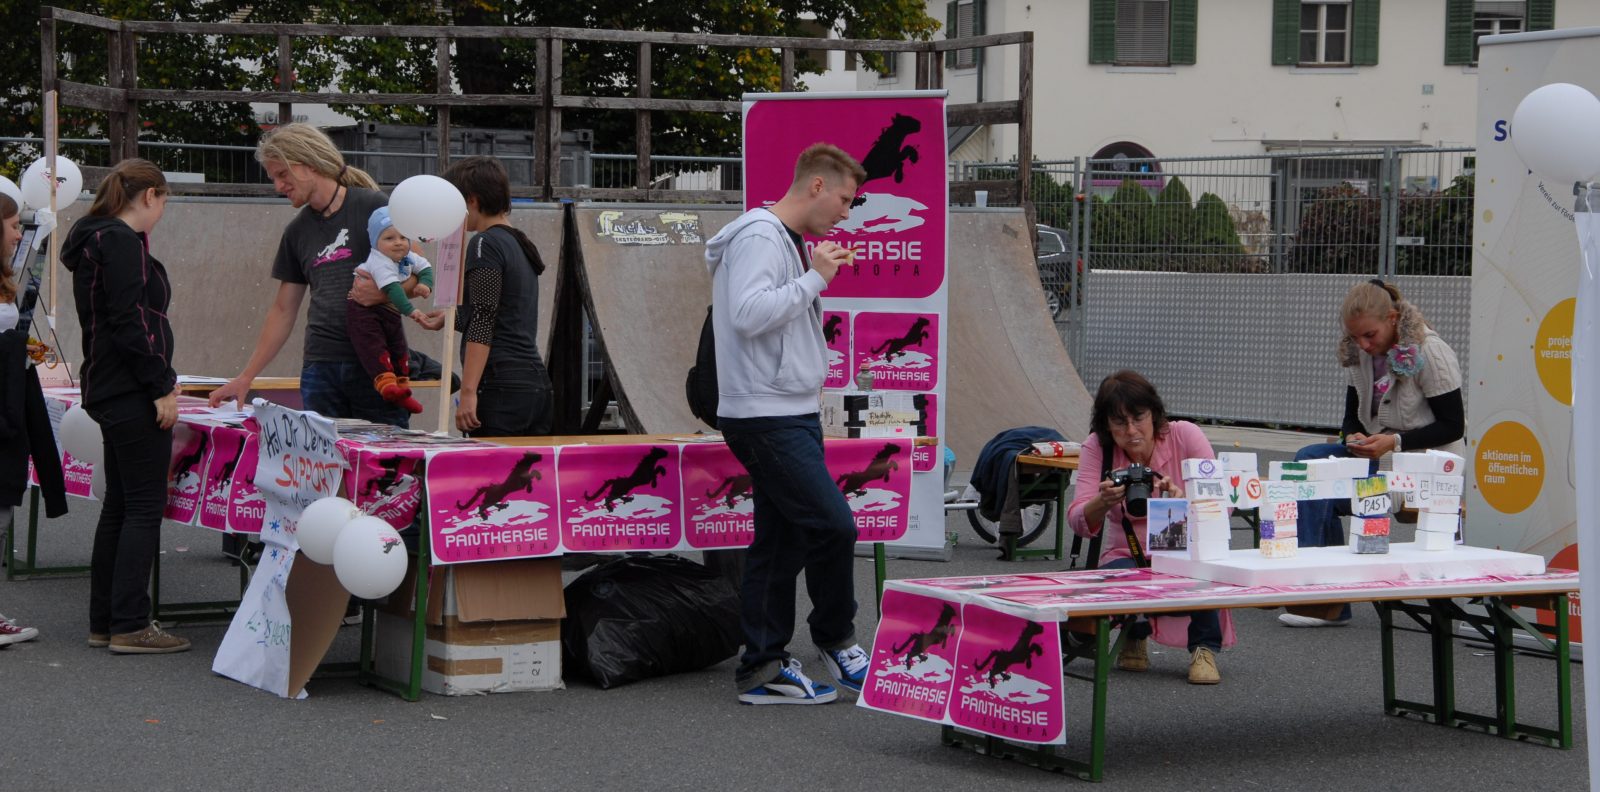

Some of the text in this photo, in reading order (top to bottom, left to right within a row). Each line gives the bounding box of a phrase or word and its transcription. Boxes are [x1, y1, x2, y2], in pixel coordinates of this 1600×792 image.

[1494, 120, 1512, 142] S
[1538, 181, 1553, 203] Verein
[1551, 200, 1562, 211] zur
[1540, 348, 1572, 359] verans
[1482, 450, 1532, 463] aktionen im
[275, 454, 340, 497] SUPPORT
[1488, 462, 1539, 476] öffentlichen
[1484, 475, 1505, 484] raum
[236, 505, 266, 519] PAN
[446, 528, 548, 548] PANTHERSIE
[572, 523, 671, 537] PANTHERSIE
[875, 678, 947, 705] PANTHERSIE
[961, 695, 1048, 726] PANTHERSIE
